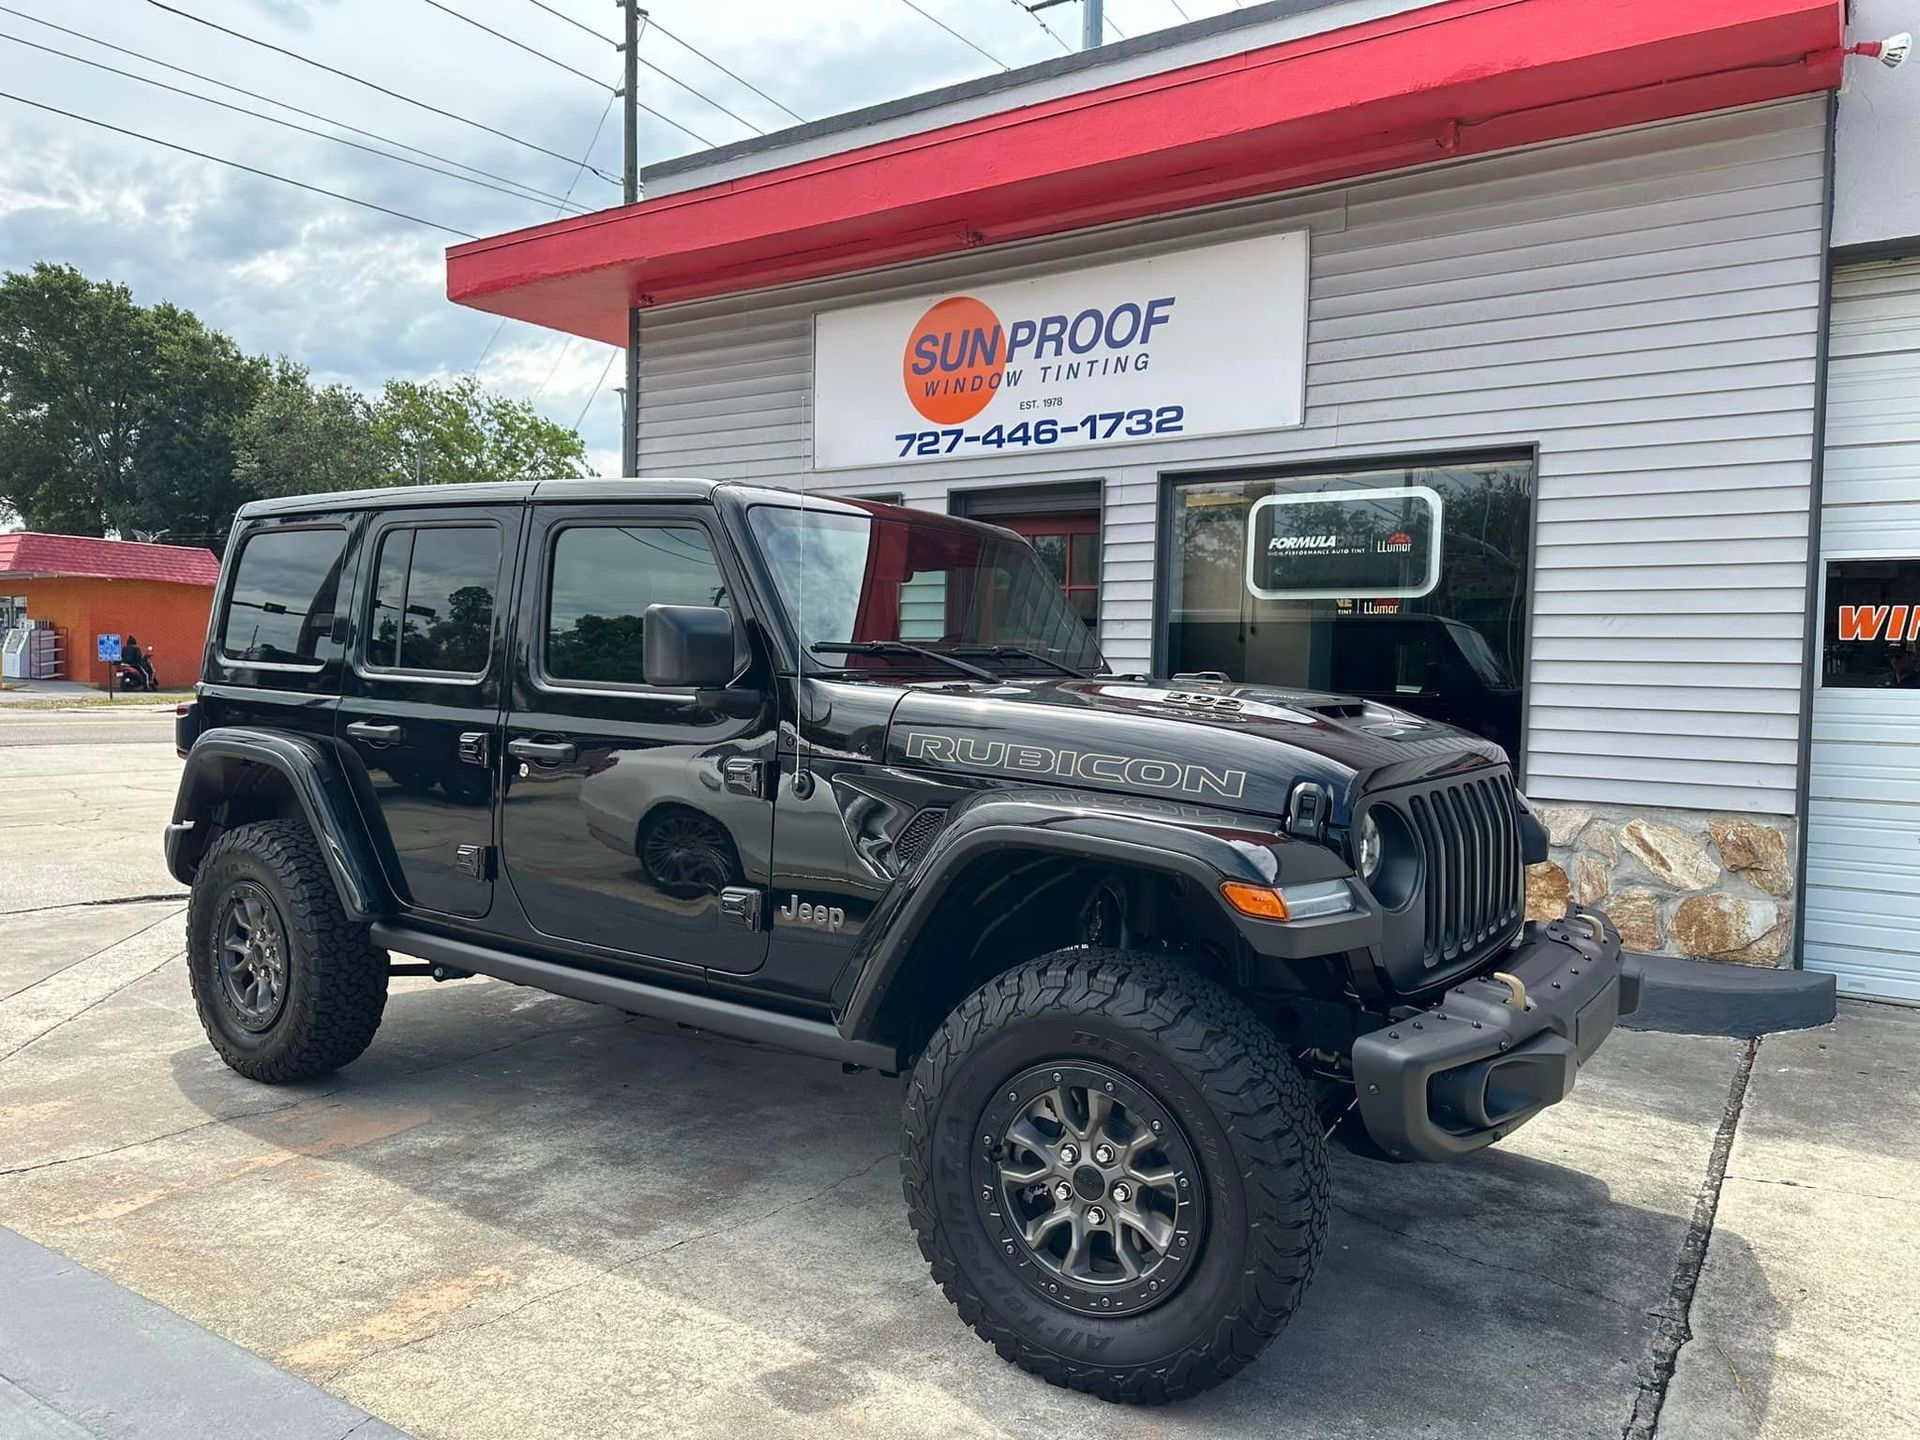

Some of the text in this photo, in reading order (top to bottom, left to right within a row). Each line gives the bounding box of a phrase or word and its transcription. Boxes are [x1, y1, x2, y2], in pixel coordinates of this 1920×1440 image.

[911, 296, 1176, 376] SUN PROOF
[925, 353, 1150, 397] WINDOW TINTING
[1019, 397, 1063, 411] EST. 1978
[895, 405, 1184, 458] 727-446-1732
[1377, 540, 1412, 553] LLumar
[905, 732, 1247, 799] RUBICON
[780, 894, 846, 933] Jeep
